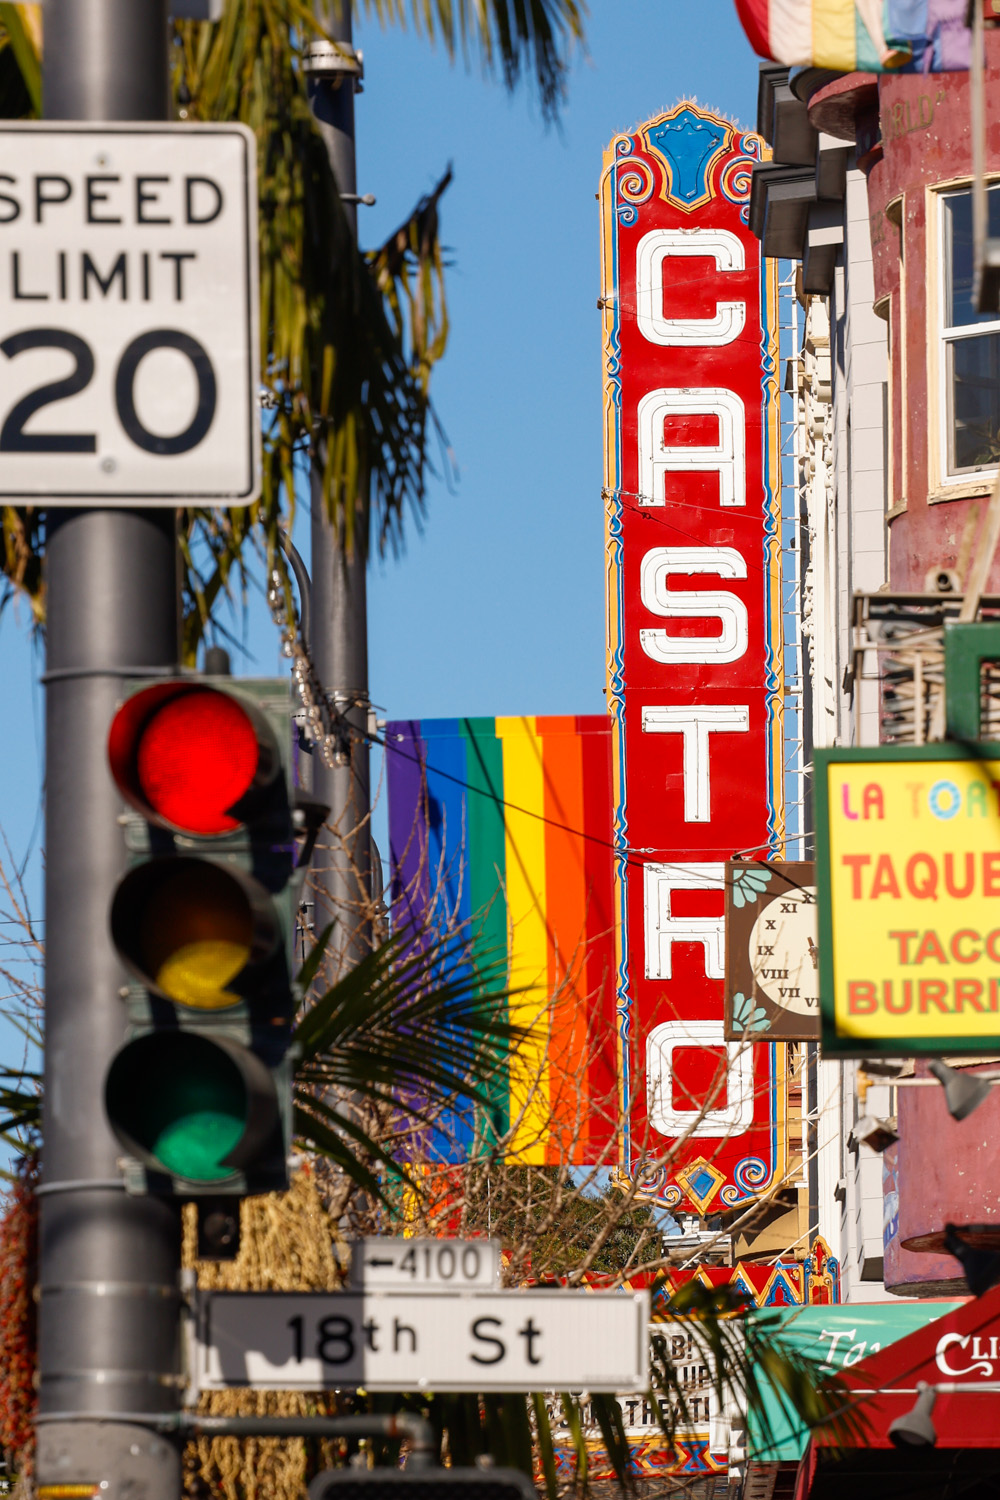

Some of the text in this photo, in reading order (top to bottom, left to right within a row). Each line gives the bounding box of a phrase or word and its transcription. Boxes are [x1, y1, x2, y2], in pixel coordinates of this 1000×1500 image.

[0, 174, 224, 225] SPEED
[11, 250, 197, 302] LIMIT
[0, 326, 218, 456] 20
[636, 229, 755, 1138] CASTRO
[841, 782, 885, 821] LA
[765, 920, 776, 930] X
[780, 903, 797, 913] XI
[757, 945, 774, 956] IX
[760, 969, 789, 979] VIII
[778, 987, 800, 998] VII
[398, 1246, 482, 1280] 4100
[287, 1314, 542, 1365] 18th St
